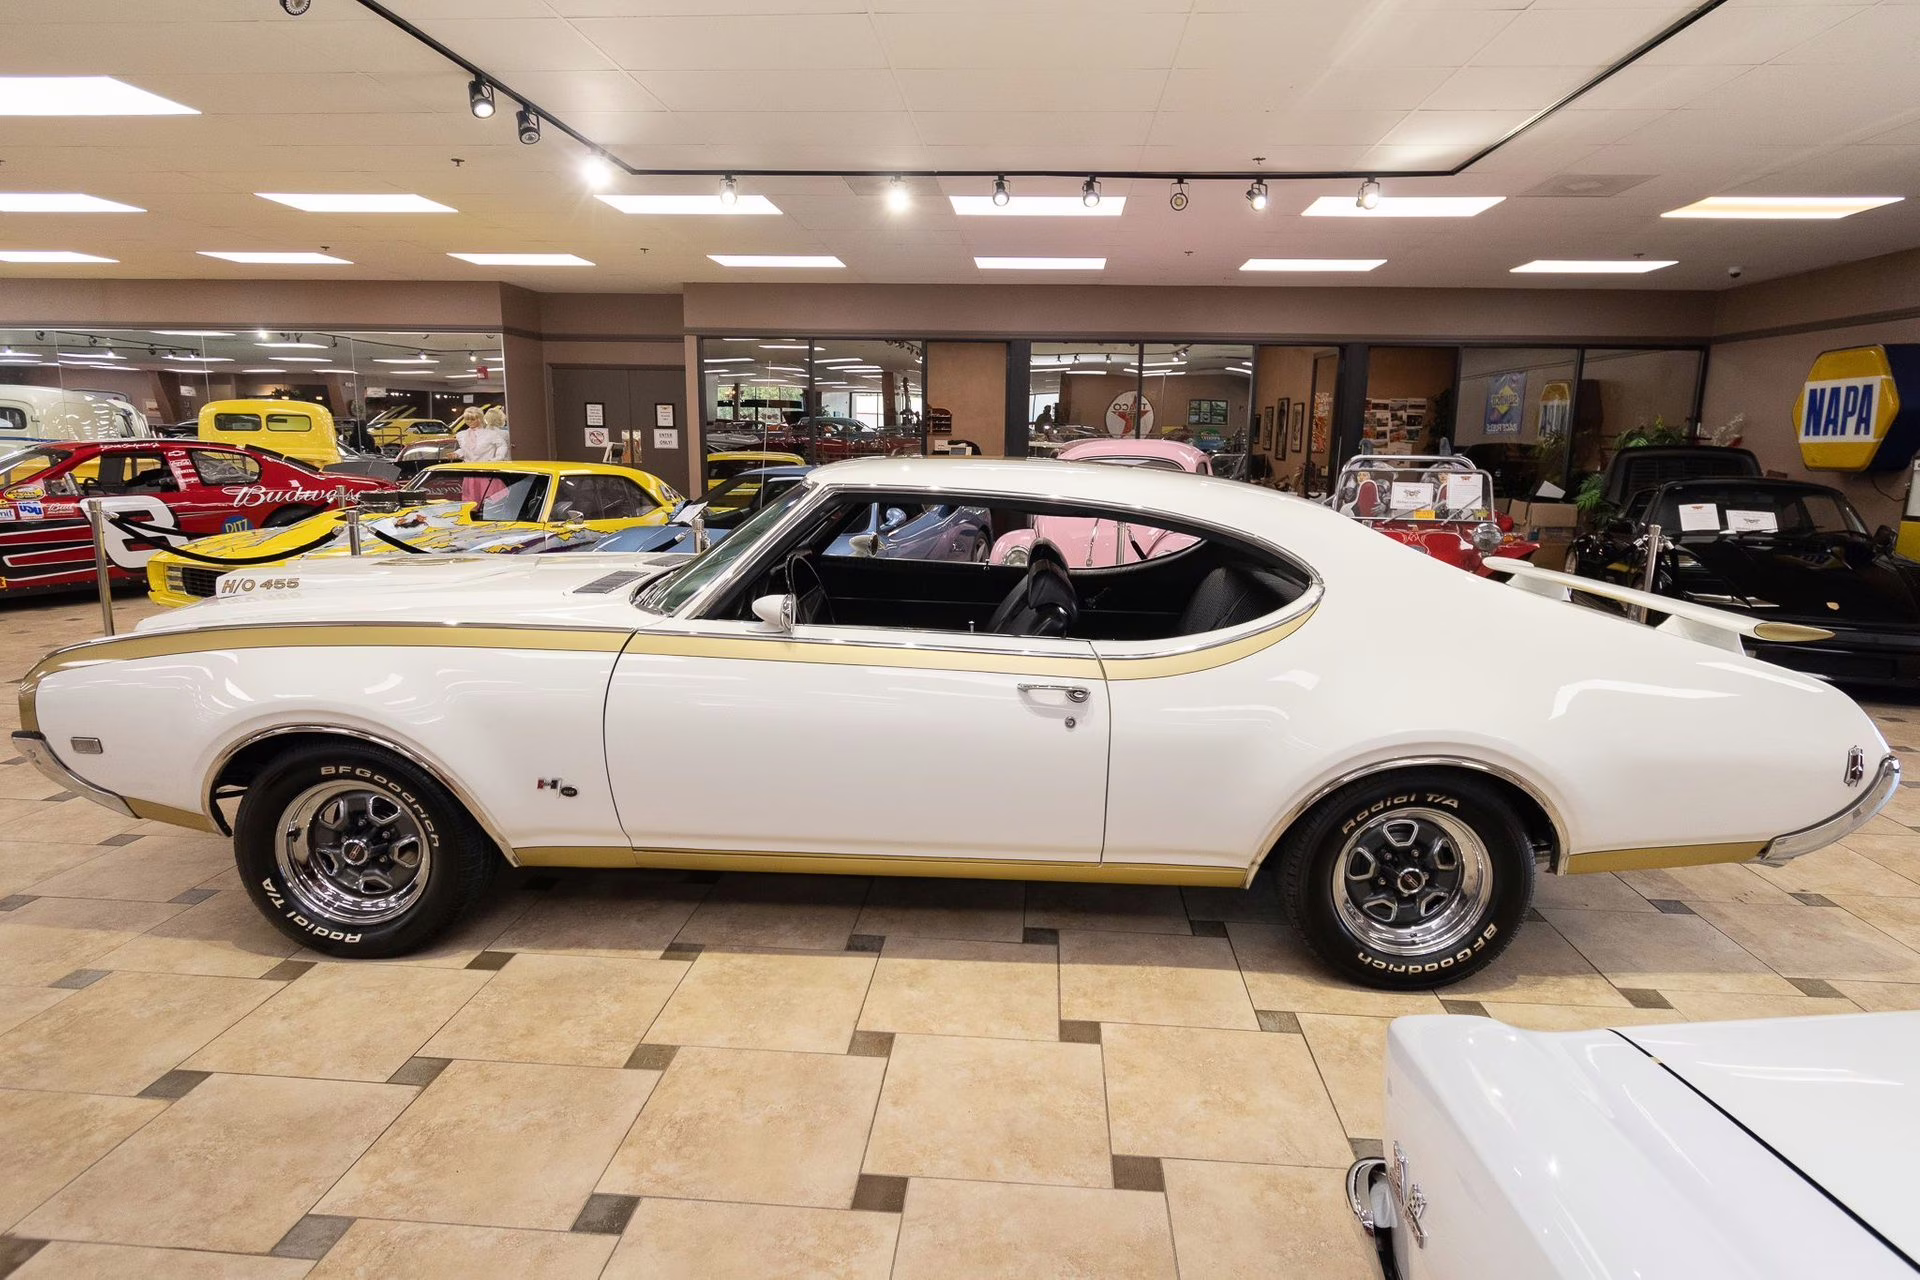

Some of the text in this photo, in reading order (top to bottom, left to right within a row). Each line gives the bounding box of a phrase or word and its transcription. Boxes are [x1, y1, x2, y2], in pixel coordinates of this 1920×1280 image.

[1803, 383, 1875, 437] NAPA
[221, 577, 300, 594] H/O 455
[320, 765, 440, 847] BFGoodrich
[1341, 793, 1460, 835] Radial T/A
[261, 877, 363, 944] Radial T/A
[1357, 923, 1499, 975] BFGoodrich
